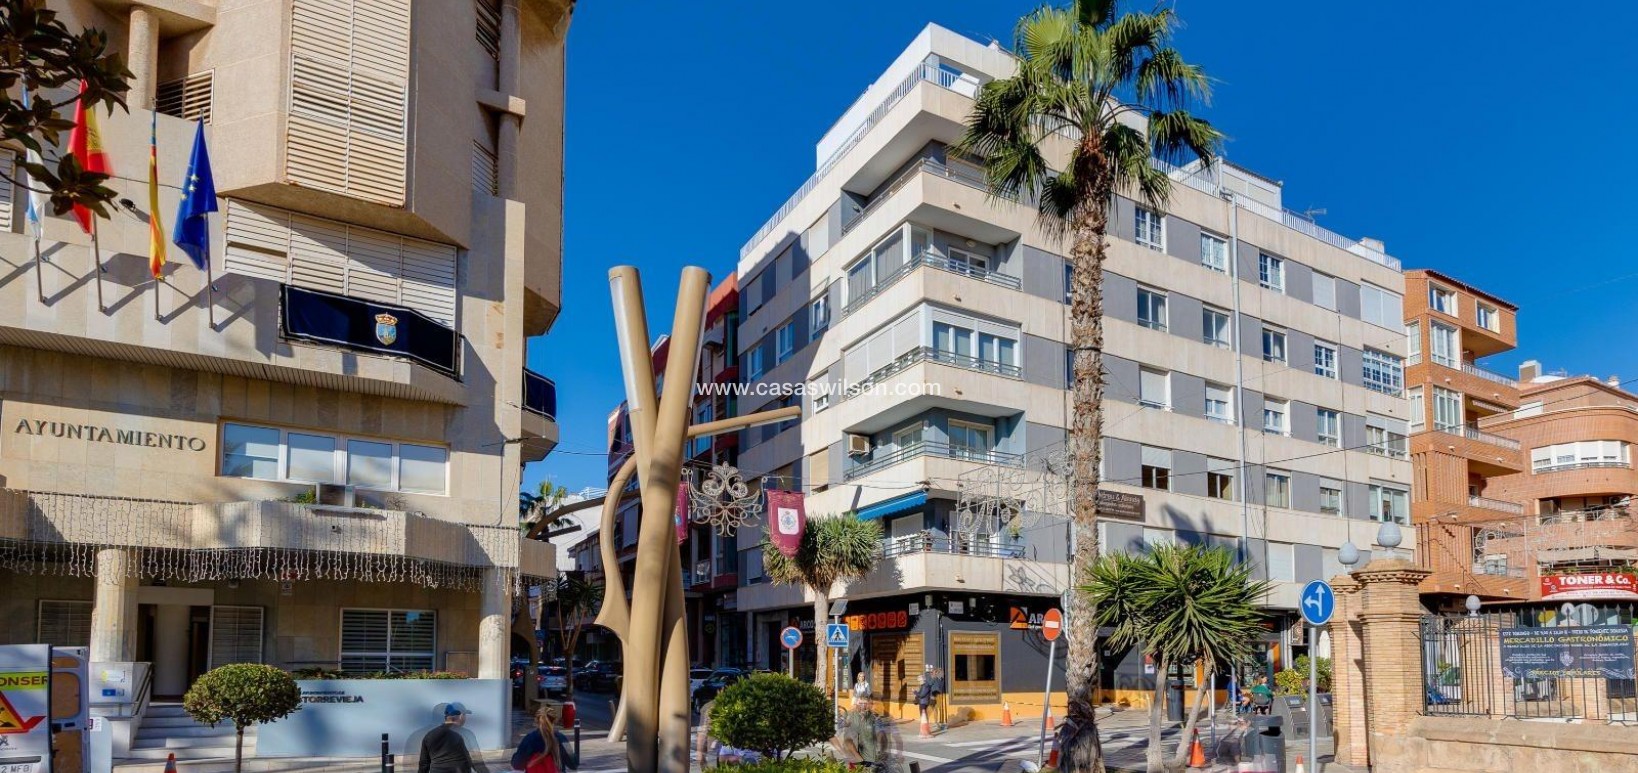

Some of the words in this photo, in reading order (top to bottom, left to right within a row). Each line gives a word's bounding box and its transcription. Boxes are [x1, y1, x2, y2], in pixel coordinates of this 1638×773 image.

[14, 418, 207, 452] AYUNTAMIENTO
[1559, 575, 1603, 585] TONER
[1605, 575, 1615, 584] &
[1503, 636, 1555, 644] MERCADILLO
[1558, 634, 1629, 643] GASTRONÓMICO
